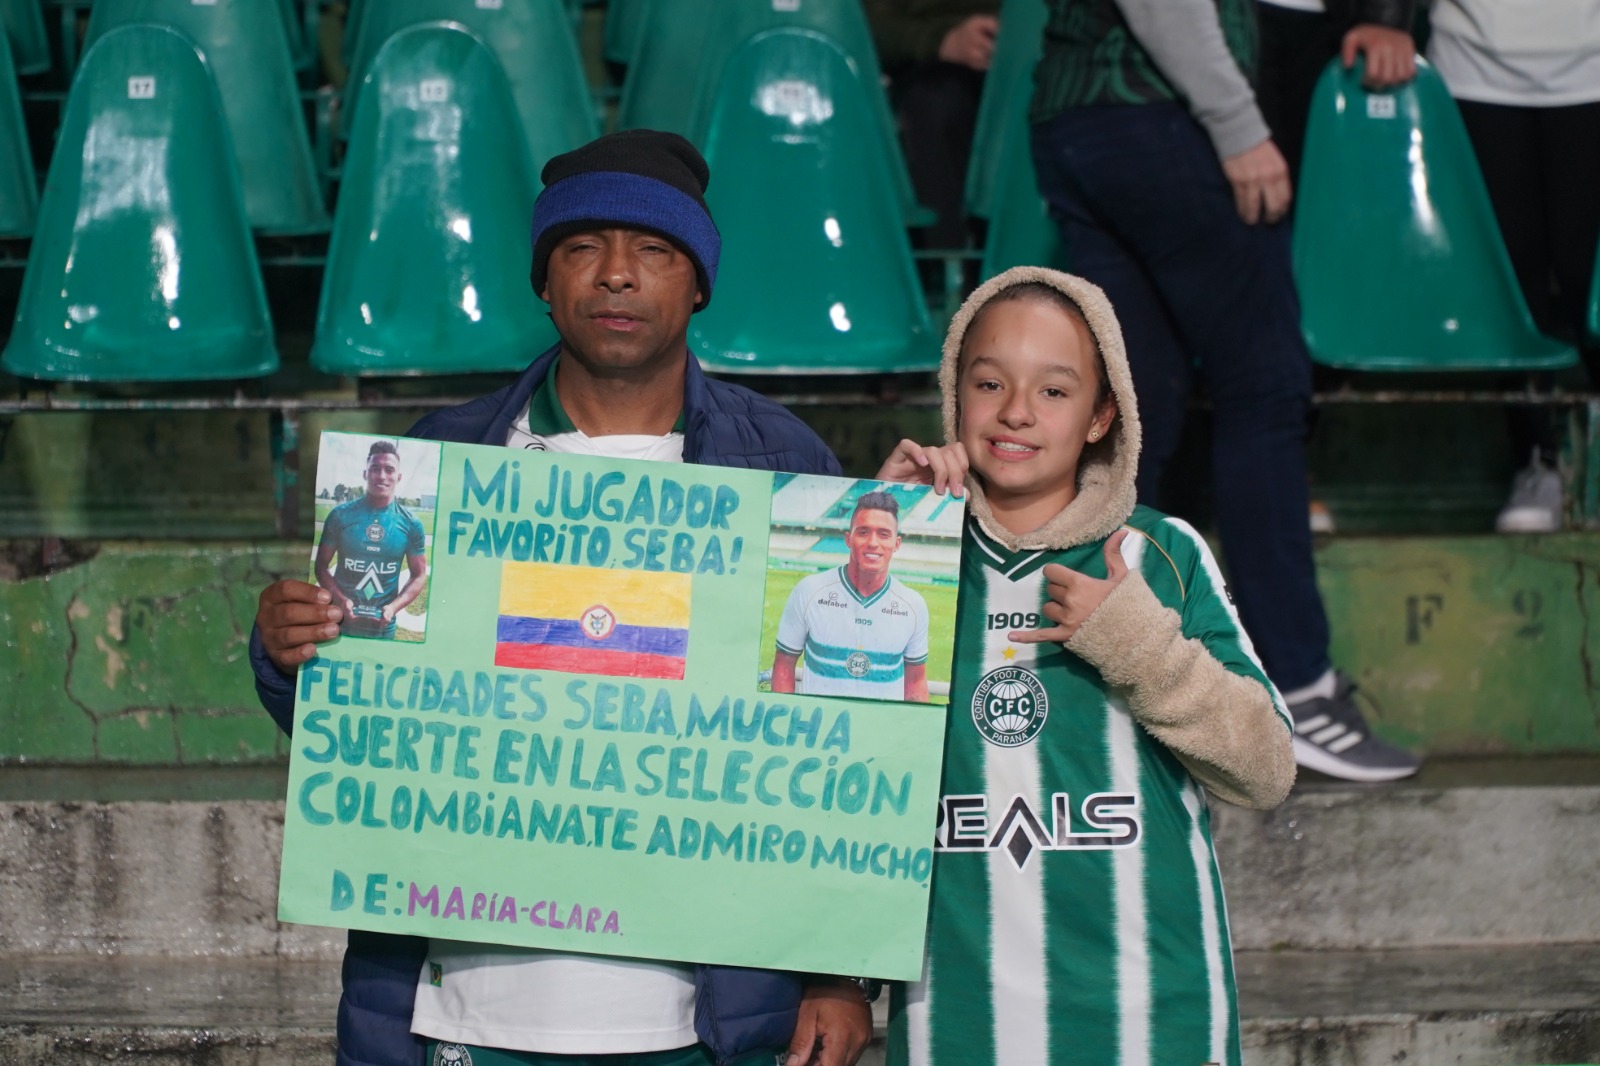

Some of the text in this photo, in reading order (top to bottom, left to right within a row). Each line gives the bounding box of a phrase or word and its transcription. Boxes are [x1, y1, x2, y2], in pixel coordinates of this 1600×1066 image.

[534, 465, 740, 529] JUGADOR
[622, 527, 743, 575] SEBA!
[344, 557, 397, 574] REALS
[817, 598, 848, 609] dafabet
[881, 607, 908, 617] dafabet
[855, 617, 873, 626] 1909
[987, 611, 1041, 630] 1909
[974, 670, 1046, 720] CORITIBA FOOT BALL CLUB
[989, 697, 1031, 717] CFC
[302, 709, 481, 780] SUERTE
[493, 729, 563, 787] EN
[570, 739, 625, 793] LA
[329, 869, 404, 916] DE:
